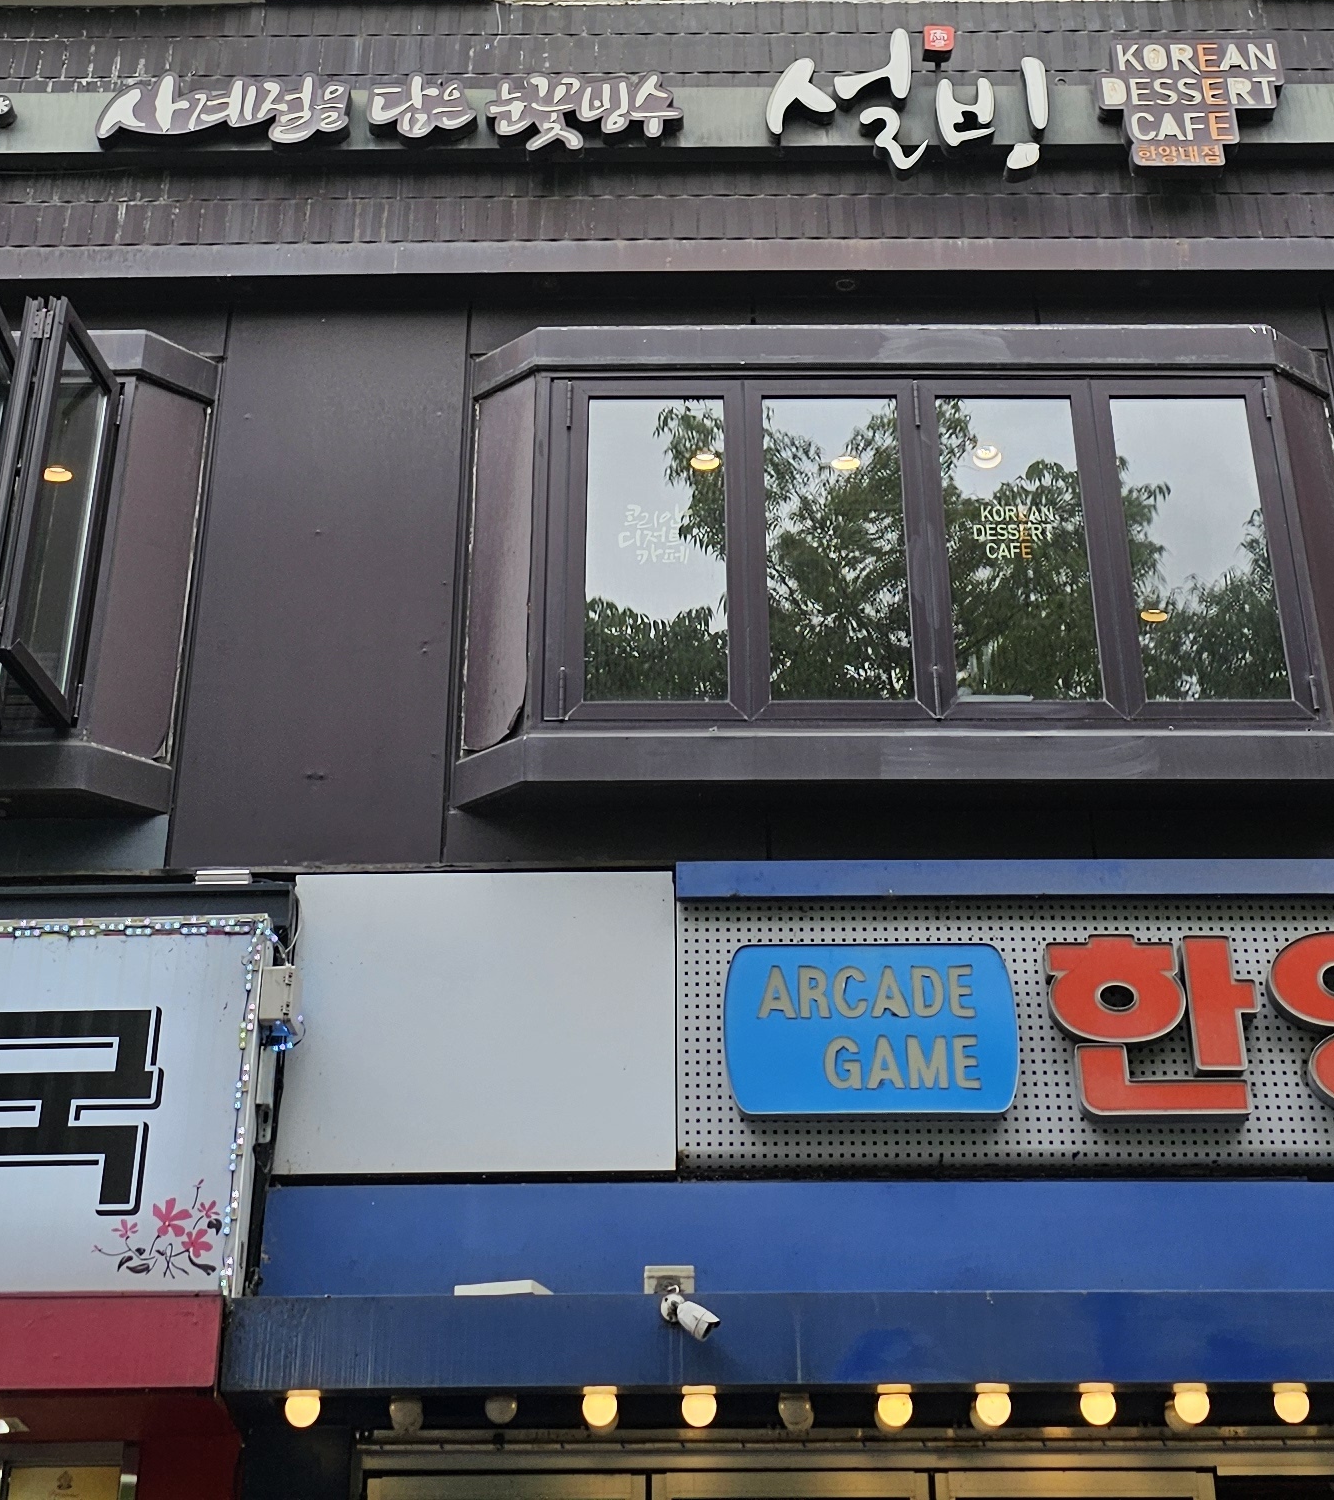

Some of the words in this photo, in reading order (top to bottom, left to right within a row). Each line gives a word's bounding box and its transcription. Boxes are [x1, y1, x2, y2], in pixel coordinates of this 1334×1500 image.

[1116, 43, 1277, 75] KOREAN
[766, 27, 1048, 169] 설빙
[1102, 77, 1275, 105] DESSERT
[99, 76, 344, 138] 사계절을
[492, 75, 677, 150] 눈꽃빙수
[1131, 111, 1234, 140] CAFE
[1138, 145, 1221, 163] 한양대점
[624, 503, 694, 528] 코리안
[981, 505, 1054, 521] KOREAN
[618, 527, 682, 548] 디저트
[973, 524, 1052, 541] DESSERT
[636, 544, 689, 565] 카페
[986, 543, 1032, 558] CAFE
[757, 964, 977, 1019] ARCADE
[822, 1034, 983, 1091] GAME
